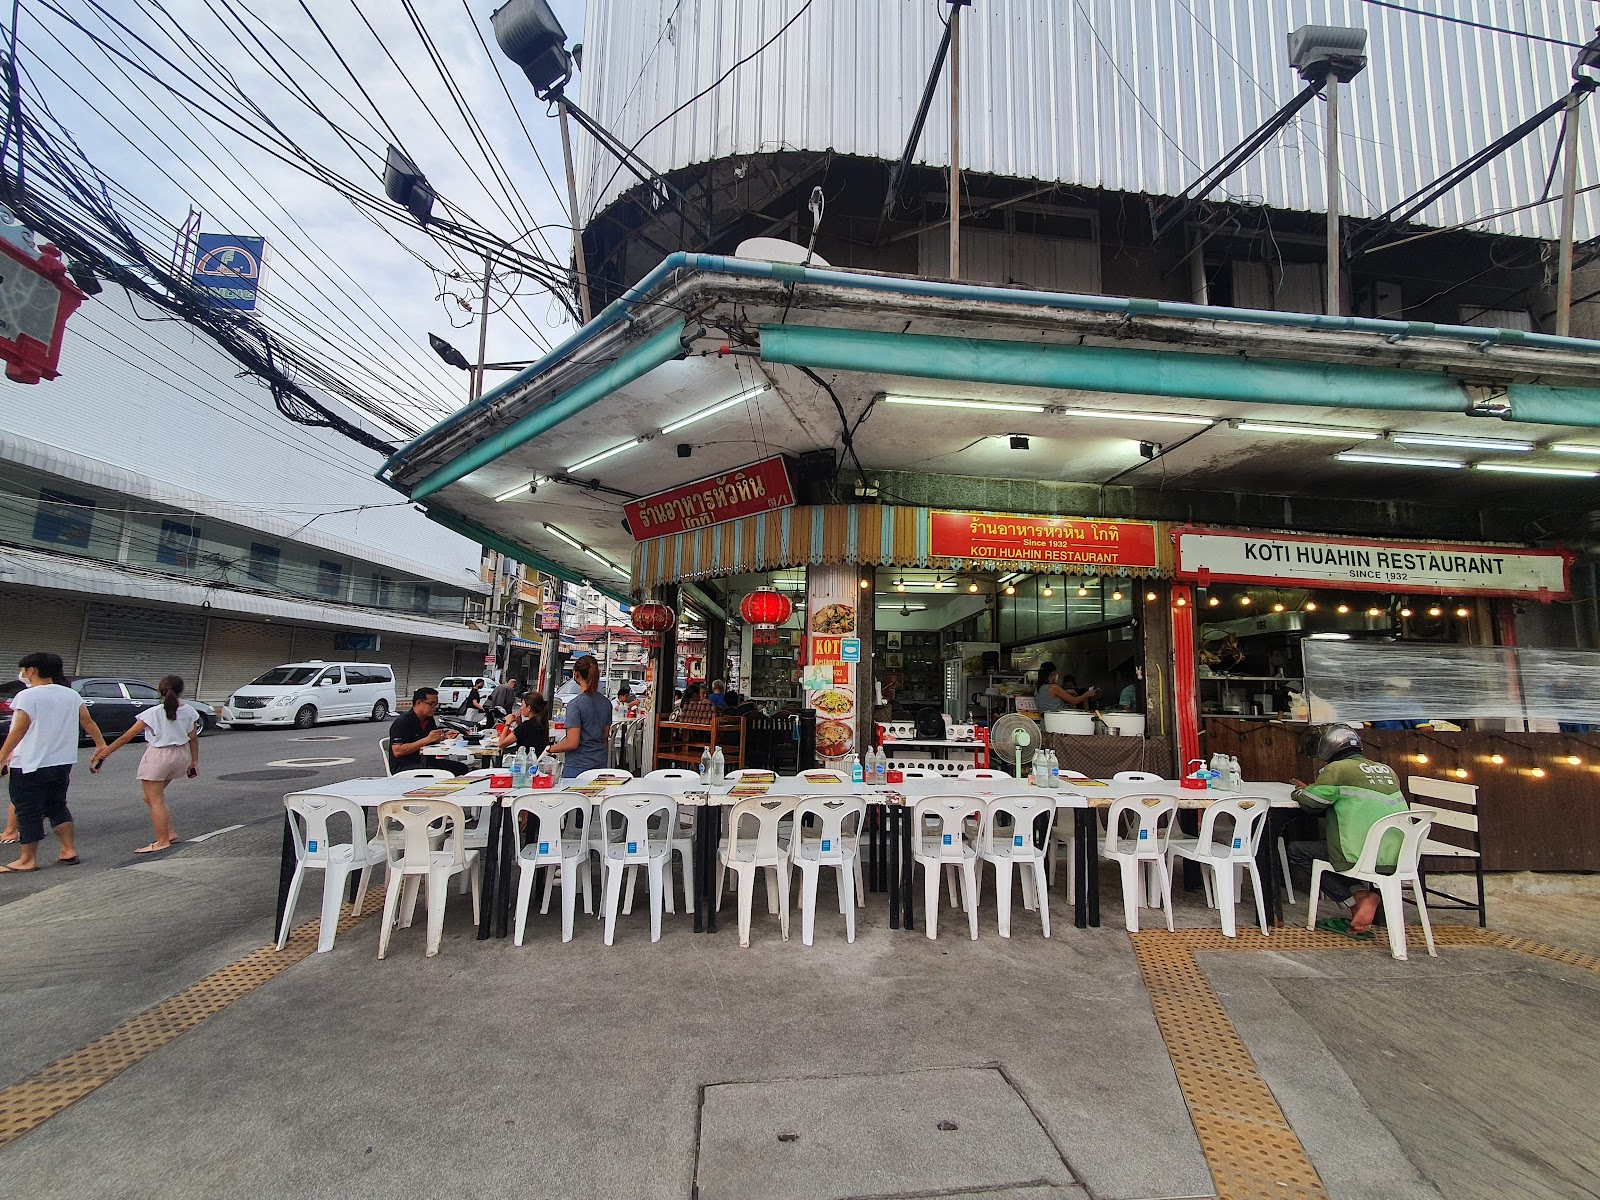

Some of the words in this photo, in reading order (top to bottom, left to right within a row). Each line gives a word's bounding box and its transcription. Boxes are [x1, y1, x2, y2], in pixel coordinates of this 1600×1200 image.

[639, 472, 766, 528] ร้านอาหารหัวหิน
[969, 517, 1085, 540] ร้านอาหารหัวหิน
[1091, 523, 1120, 542] โกทิ
[1023, 538, 1047, 547] Since
[1048, 540, 1068, 548] 1932
[970, 546, 997, 557] KOTI
[999, 547, 1042, 560] HUAHIN
[1044, 550, 1119, 563] RESTAURANT
[1244, 543, 1290, 562] KOTI
[1296, 546, 1371, 568] HUAHIN
[1377, 552, 1504, 575] RESTAURANT
[1349, 569, 1381, 579] SINCE
[1385, 572, 1408, 581] 1932
[816, 639, 841, 655] KOT
[1358, 763, 1390, 774] Grab
